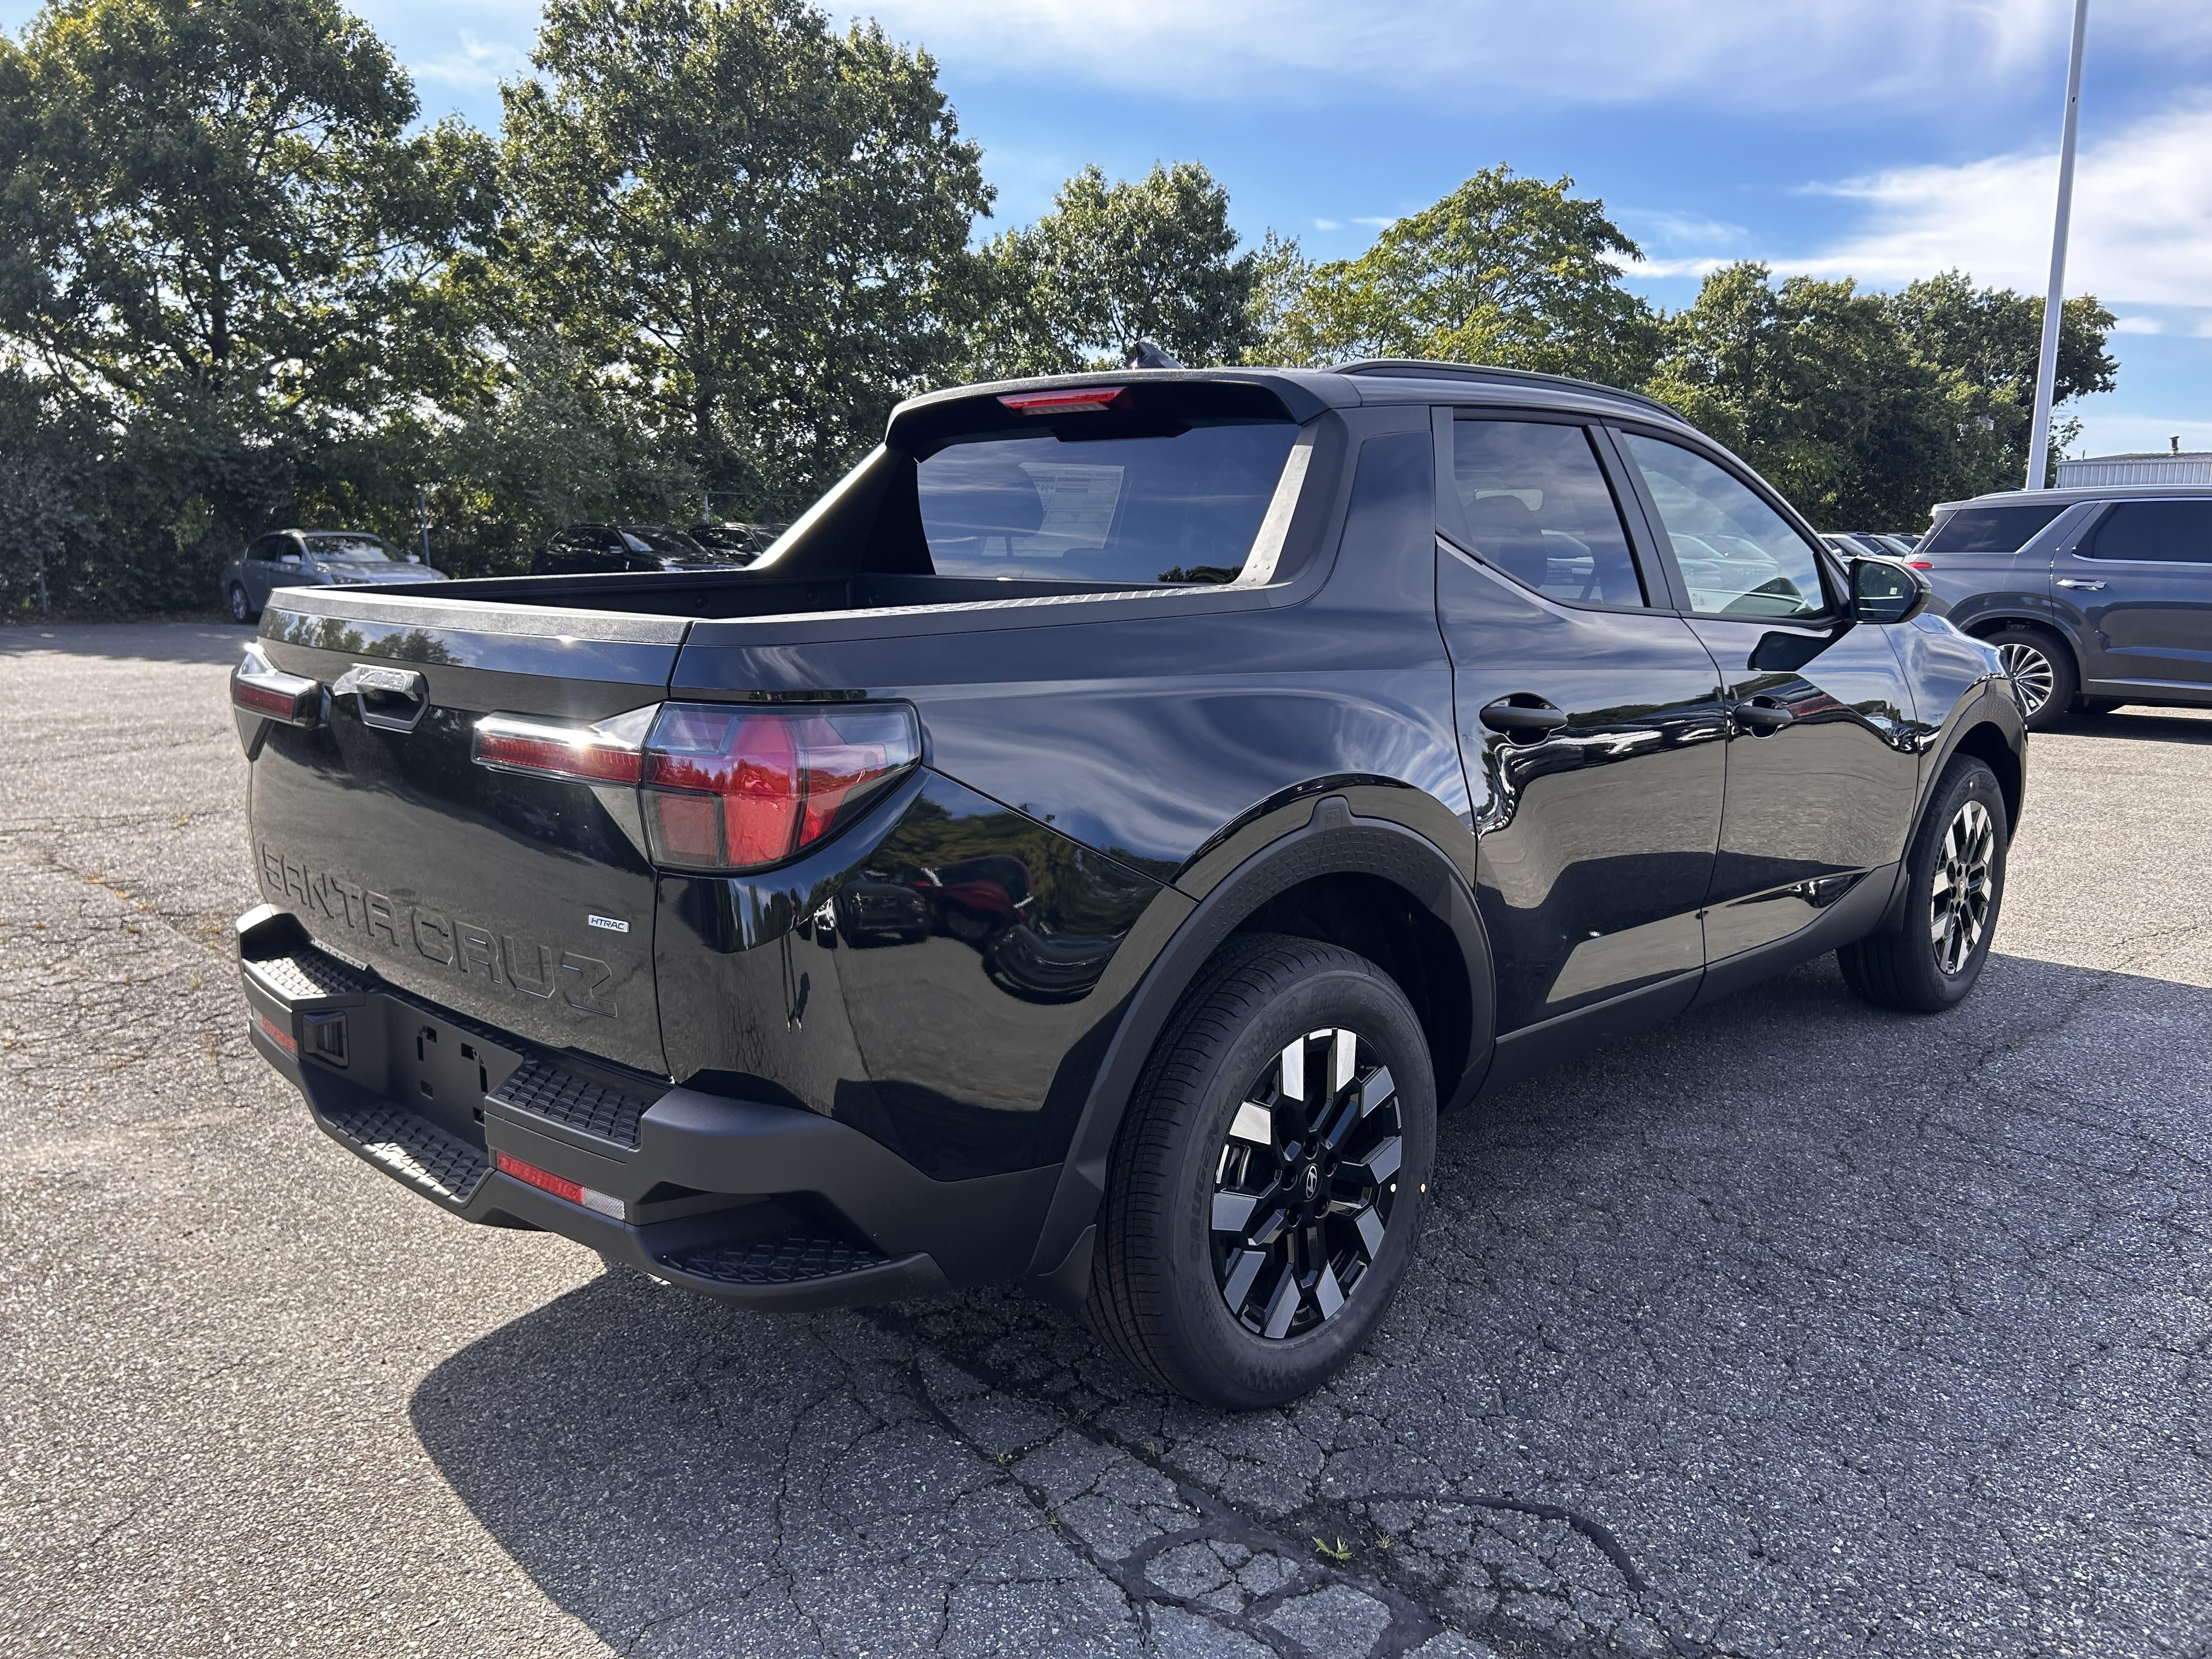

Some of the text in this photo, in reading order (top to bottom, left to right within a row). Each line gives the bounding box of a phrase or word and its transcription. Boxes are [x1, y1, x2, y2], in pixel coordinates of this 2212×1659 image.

[262, 843, 618, 1018] SANTA CRUZ
[591, 917, 625, 930] HTRAC
[1189, 1113, 1221, 1263] CRUGEN
